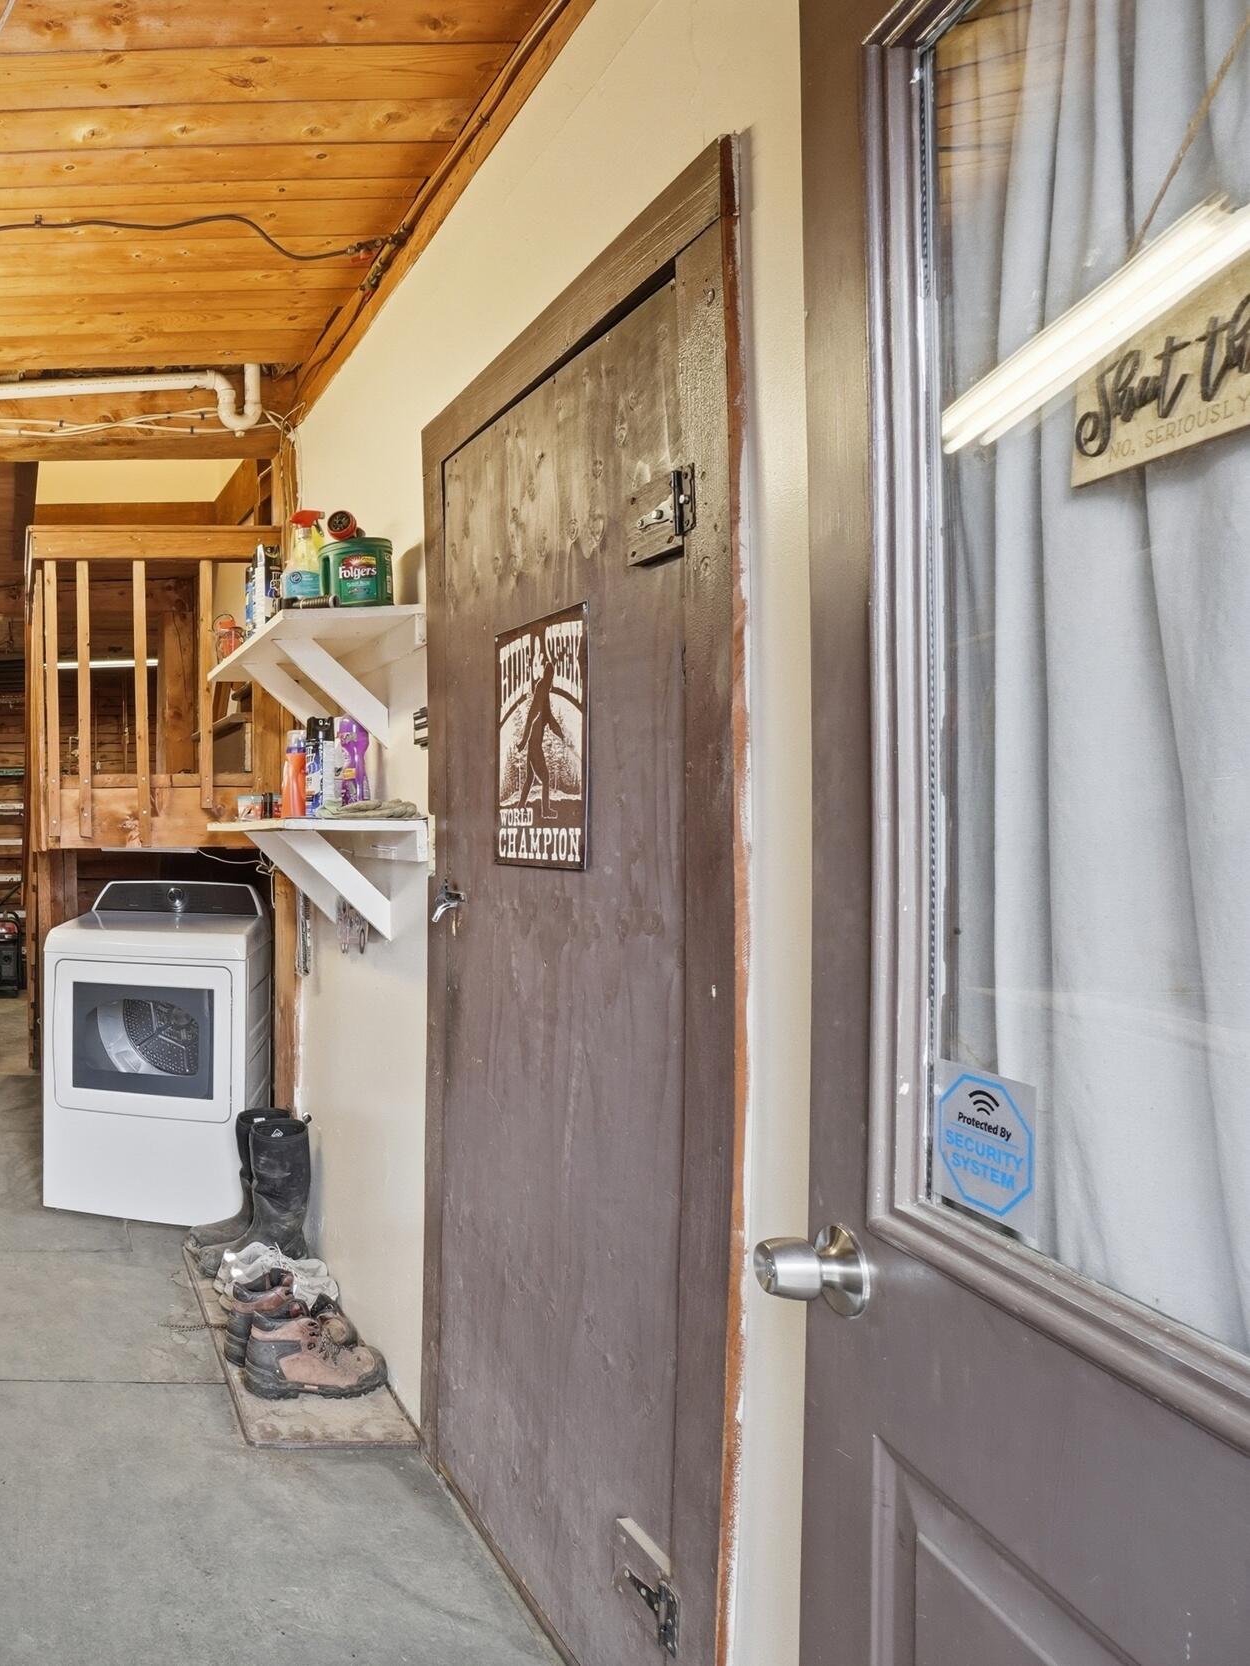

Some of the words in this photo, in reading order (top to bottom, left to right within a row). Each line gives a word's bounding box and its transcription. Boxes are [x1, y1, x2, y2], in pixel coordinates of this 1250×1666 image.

[1075, 335, 1191, 457] Shut
[1109, 439, 1136, 462] NO,
[338, 566, 377, 580] Folgers
[500, 633, 531, 722] HIDE
[532, 636, 544, 680] &
[499, 807, 534, 827] WORLD
[499, 827, 581, 862] CHAMPION
[957, 1112, 999, 1135] Protected
[999, 1127, 1012, 1141] By
[945, 1129, 1024, 1173] SECURITY
[951, 1152, 1016, 1190] SYSTEM
